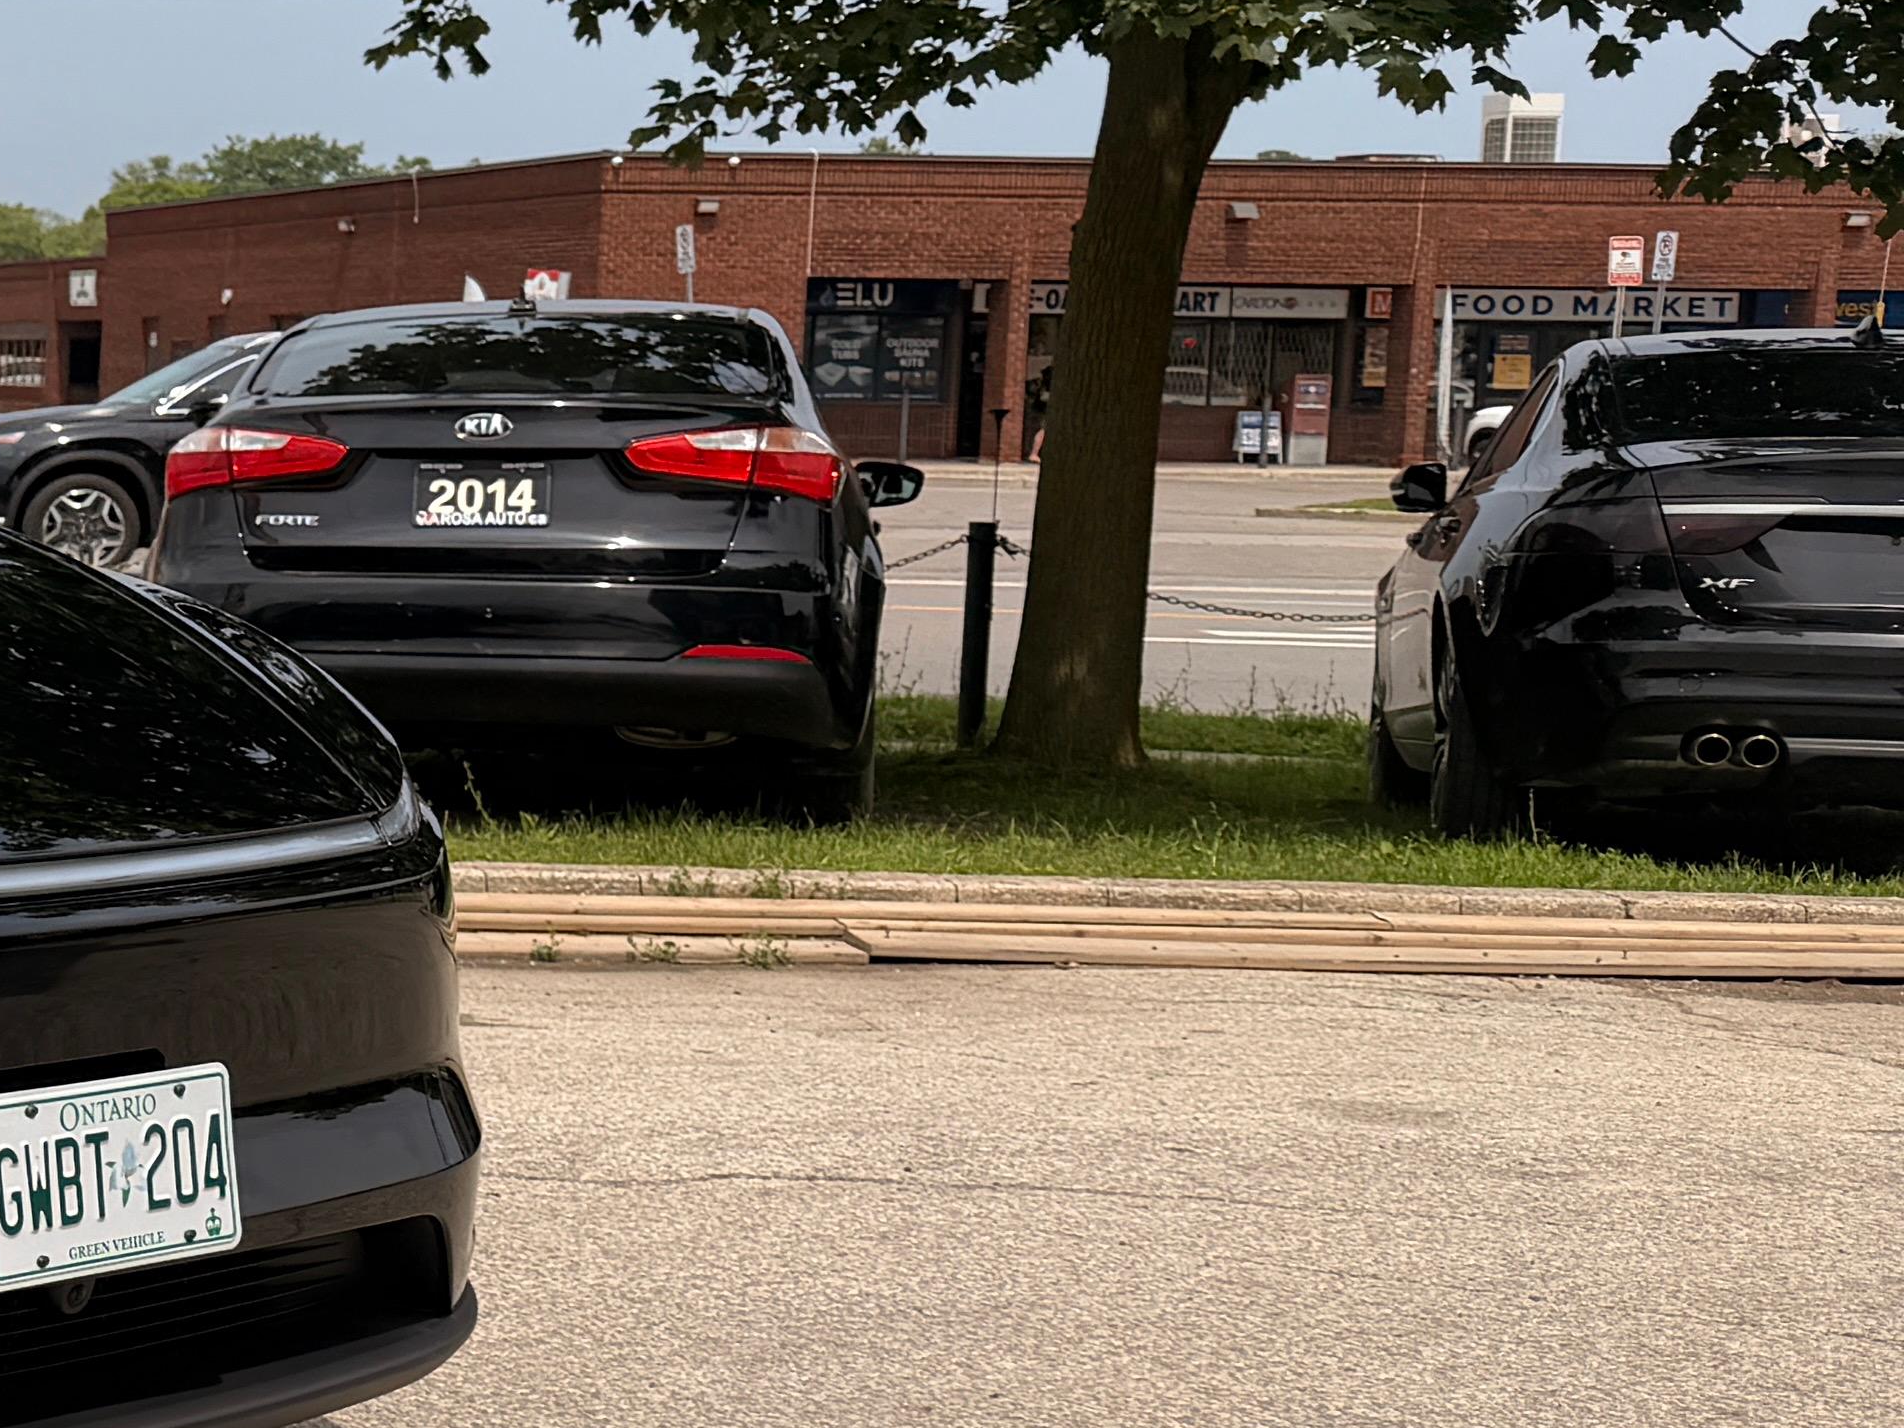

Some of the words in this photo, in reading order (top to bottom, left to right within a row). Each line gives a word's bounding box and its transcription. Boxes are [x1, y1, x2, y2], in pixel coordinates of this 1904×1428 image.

[1453, 294, 1553, 316] FOOD
[1573, 295, 1733, 317] MARKET
[464, 413, 503, 435] KIA
[428, 478, 536, 514] 2014
[255, 515, 320, 526] FORTE
[1698, 577, 1756, 589] XF
[60, 1093, 157, 1132] ONTARIO
[143, 1113, 228, 1211] 204
[68, 1240, 111, 1261] GREEN
[112, 1230, 167, 1253] VEHICLE
